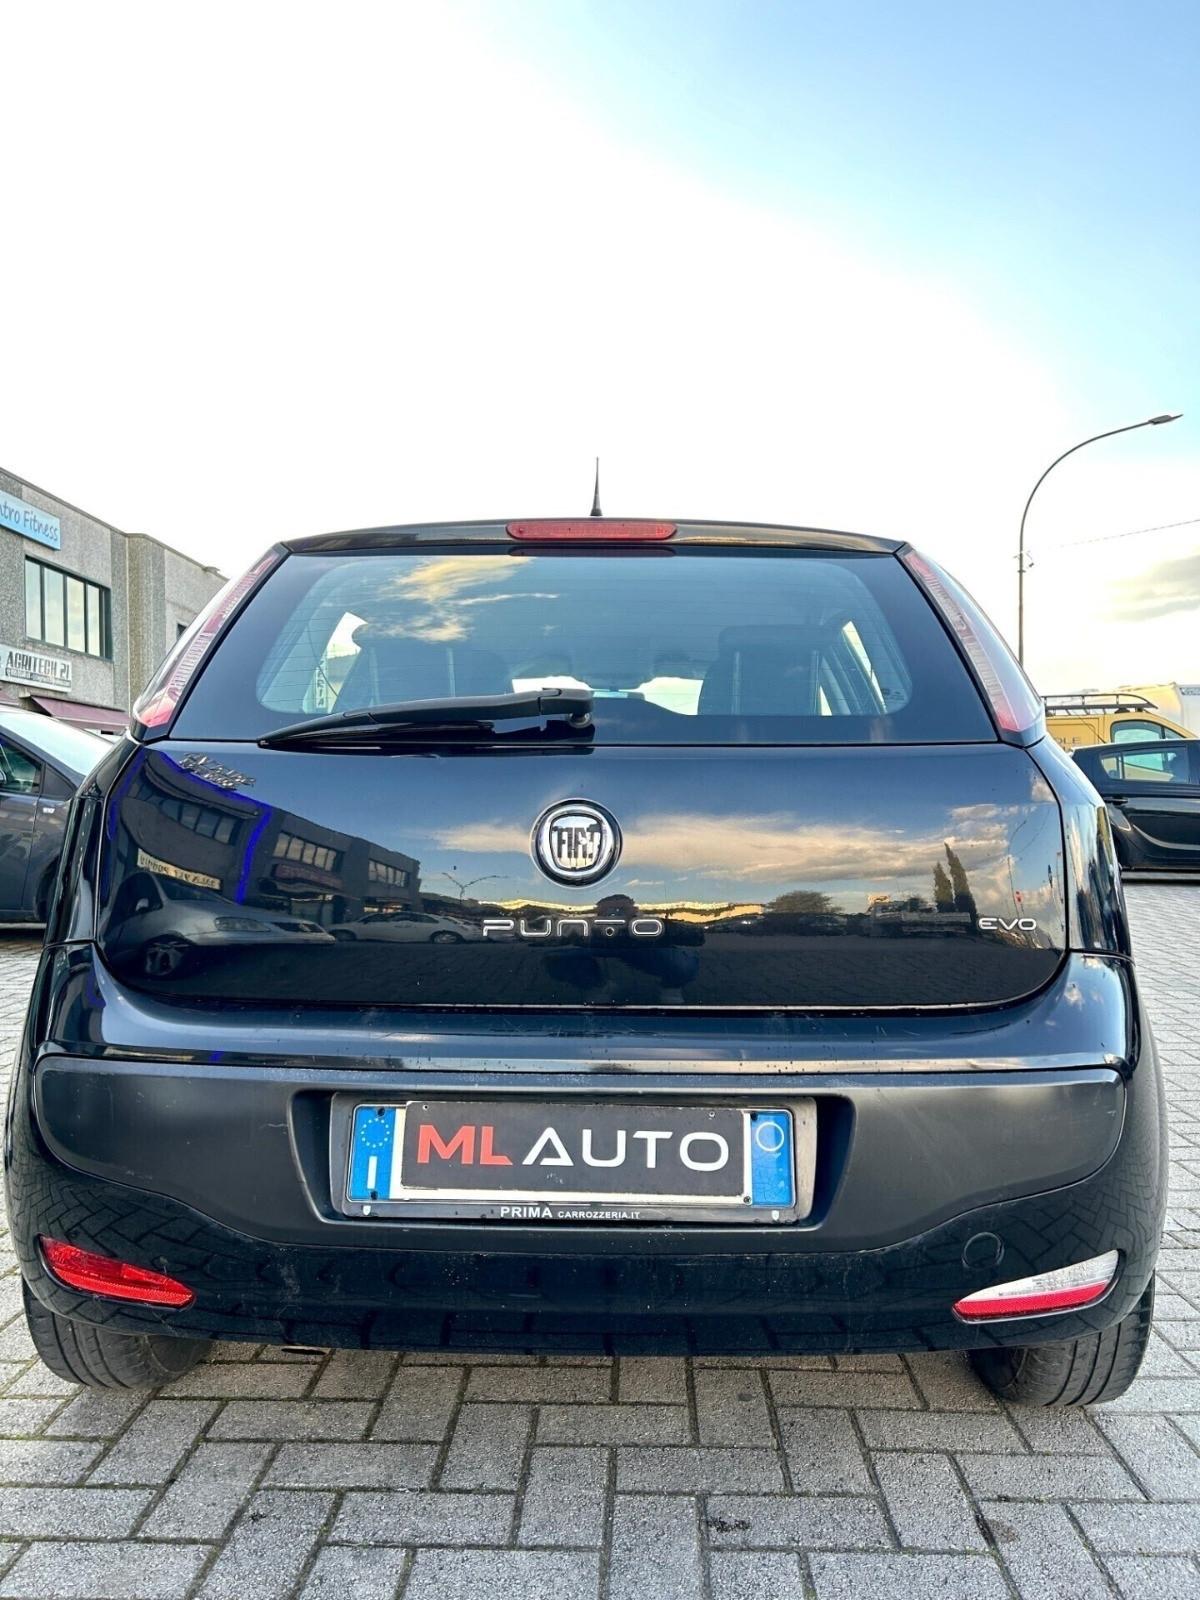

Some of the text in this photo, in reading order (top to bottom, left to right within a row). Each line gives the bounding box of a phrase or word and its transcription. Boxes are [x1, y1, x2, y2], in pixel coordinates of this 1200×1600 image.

[23, 510, 58, 542] Fitness
[6, 651, 57, 677] AGRITECH
[551, 822, 602, 866] FIAT
[482, 919, 663, 937] PUNTO
[978, 917, 1037, 931] EVO
[417, 1124, 729, 1172] ML AUTO
[500, 1206, 641, 1220] PRIMA CARROZZERIA.IT
